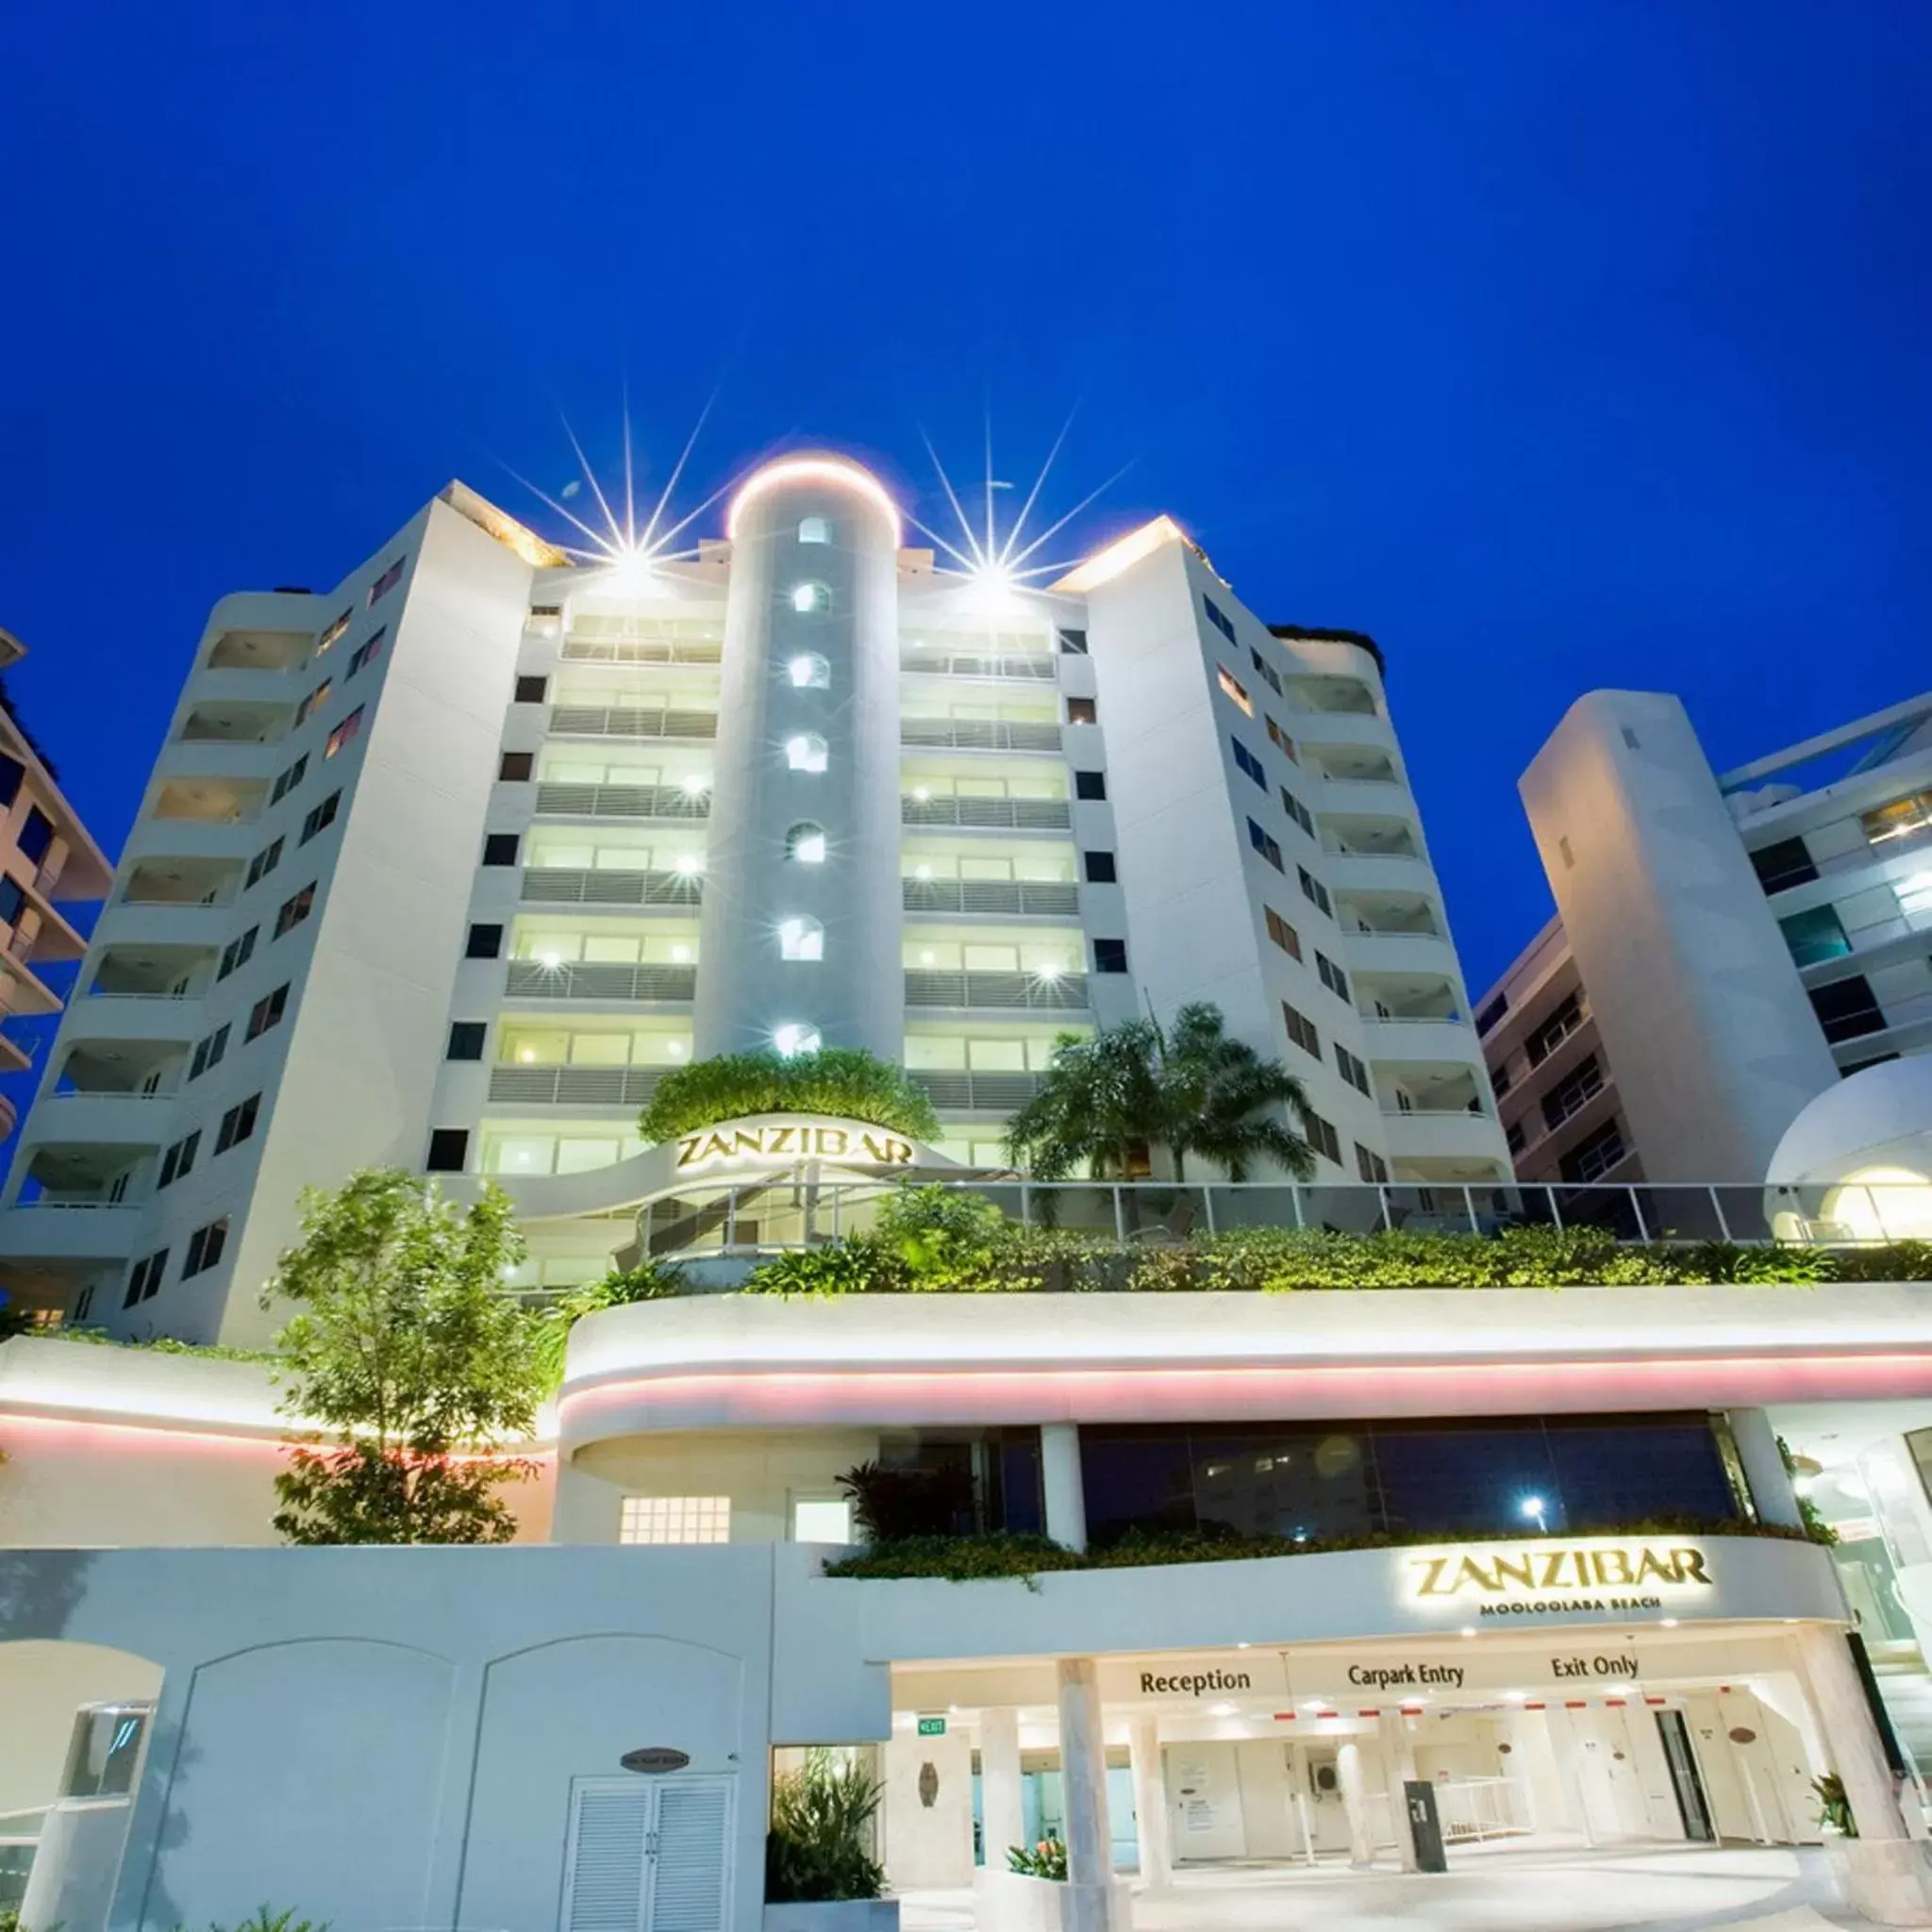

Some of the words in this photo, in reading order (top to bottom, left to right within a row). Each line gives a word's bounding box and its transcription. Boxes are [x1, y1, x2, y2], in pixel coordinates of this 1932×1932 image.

[678, 1128, 913, 1168] ZANZIBAR
[1411, 1548, 1712, 1596] ZANZIBAR
[1480, 1600, 1605, 1616] MOOLOOLABA
[1610, 1597, 1661, 1610] BEACH
[1348, 1664, 1416, 1690] Carpark
[1418, 1664, 1464, 1689] Entry
[1551, 1657, 1589, 1677] Exit
[1593, 1655, 1638, 1679] Only
[1141, 1670, 1251, 1697] Reception
